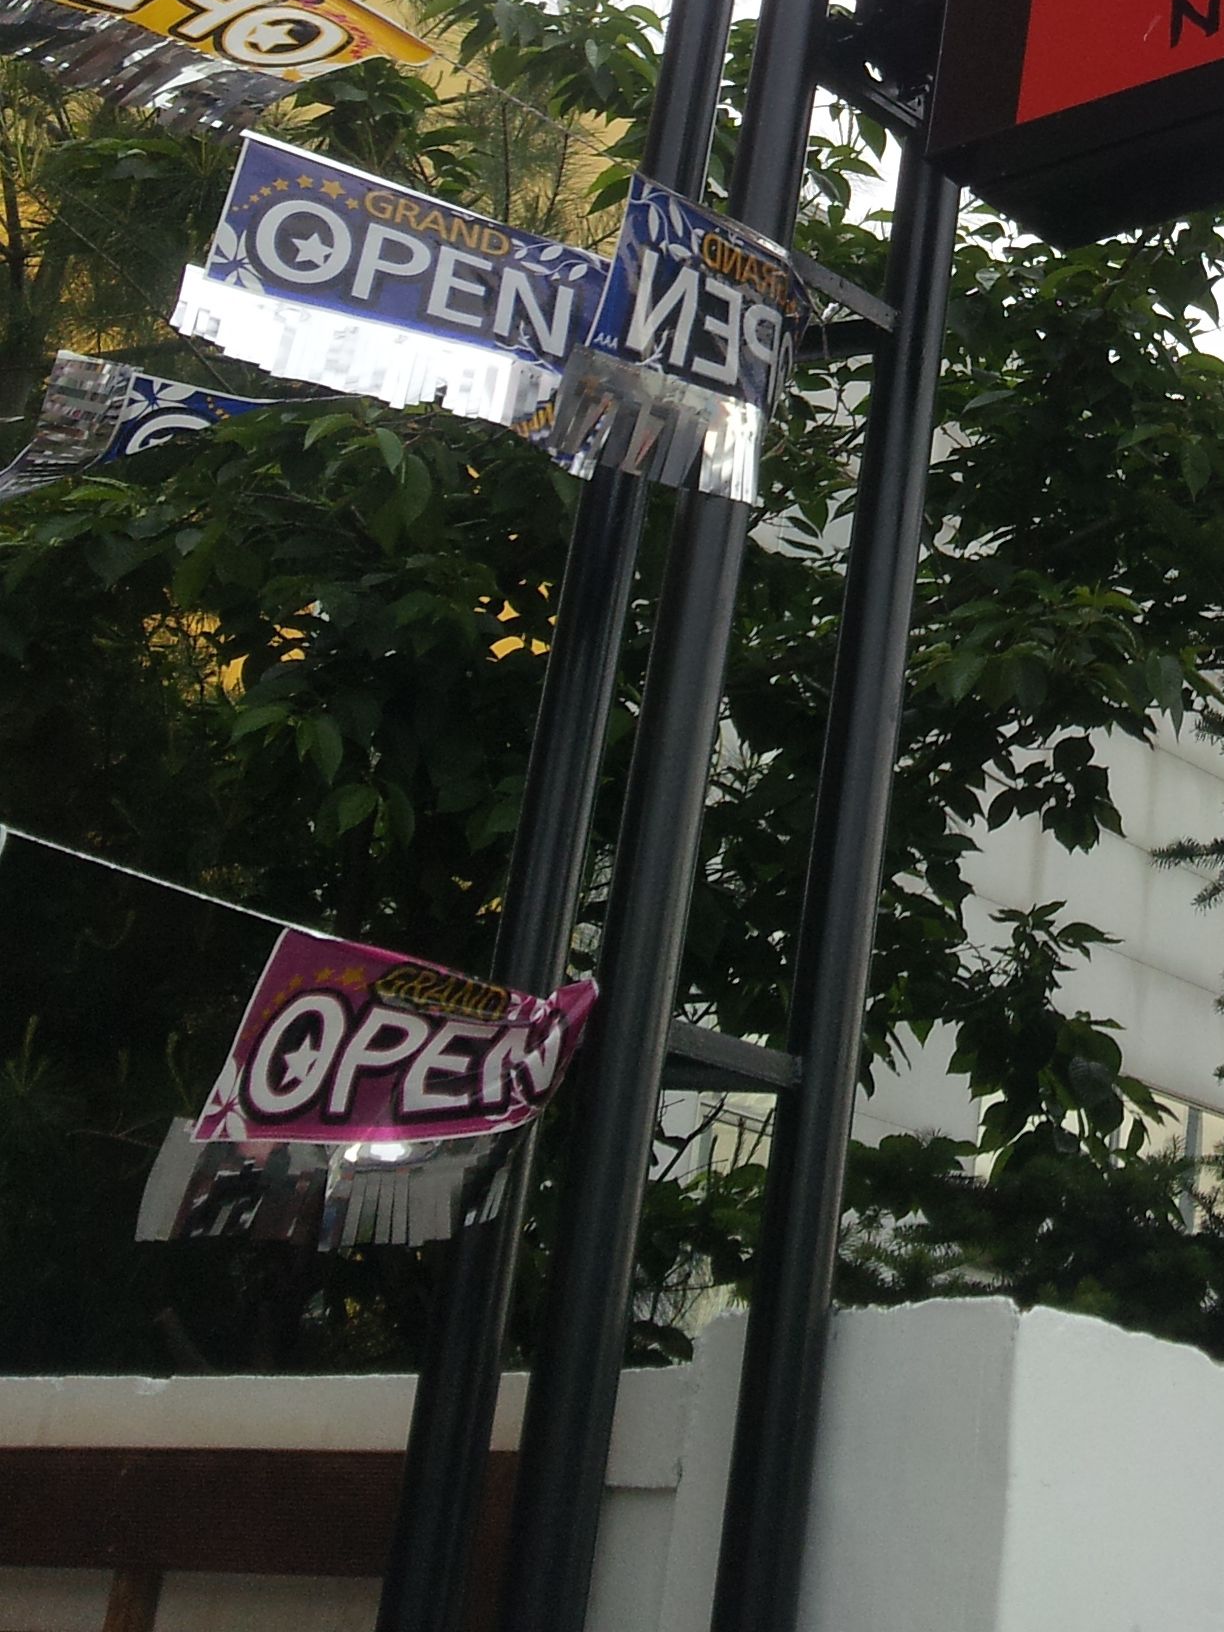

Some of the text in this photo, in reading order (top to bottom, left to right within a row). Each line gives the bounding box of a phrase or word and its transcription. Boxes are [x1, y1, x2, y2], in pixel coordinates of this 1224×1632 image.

[363, 189, 513, 256] GRAND
[255, 199, 575, 358] OPEN
[374, 964, 509, 1021] GRAND
[248, 994, 563, 1115] OPEN
